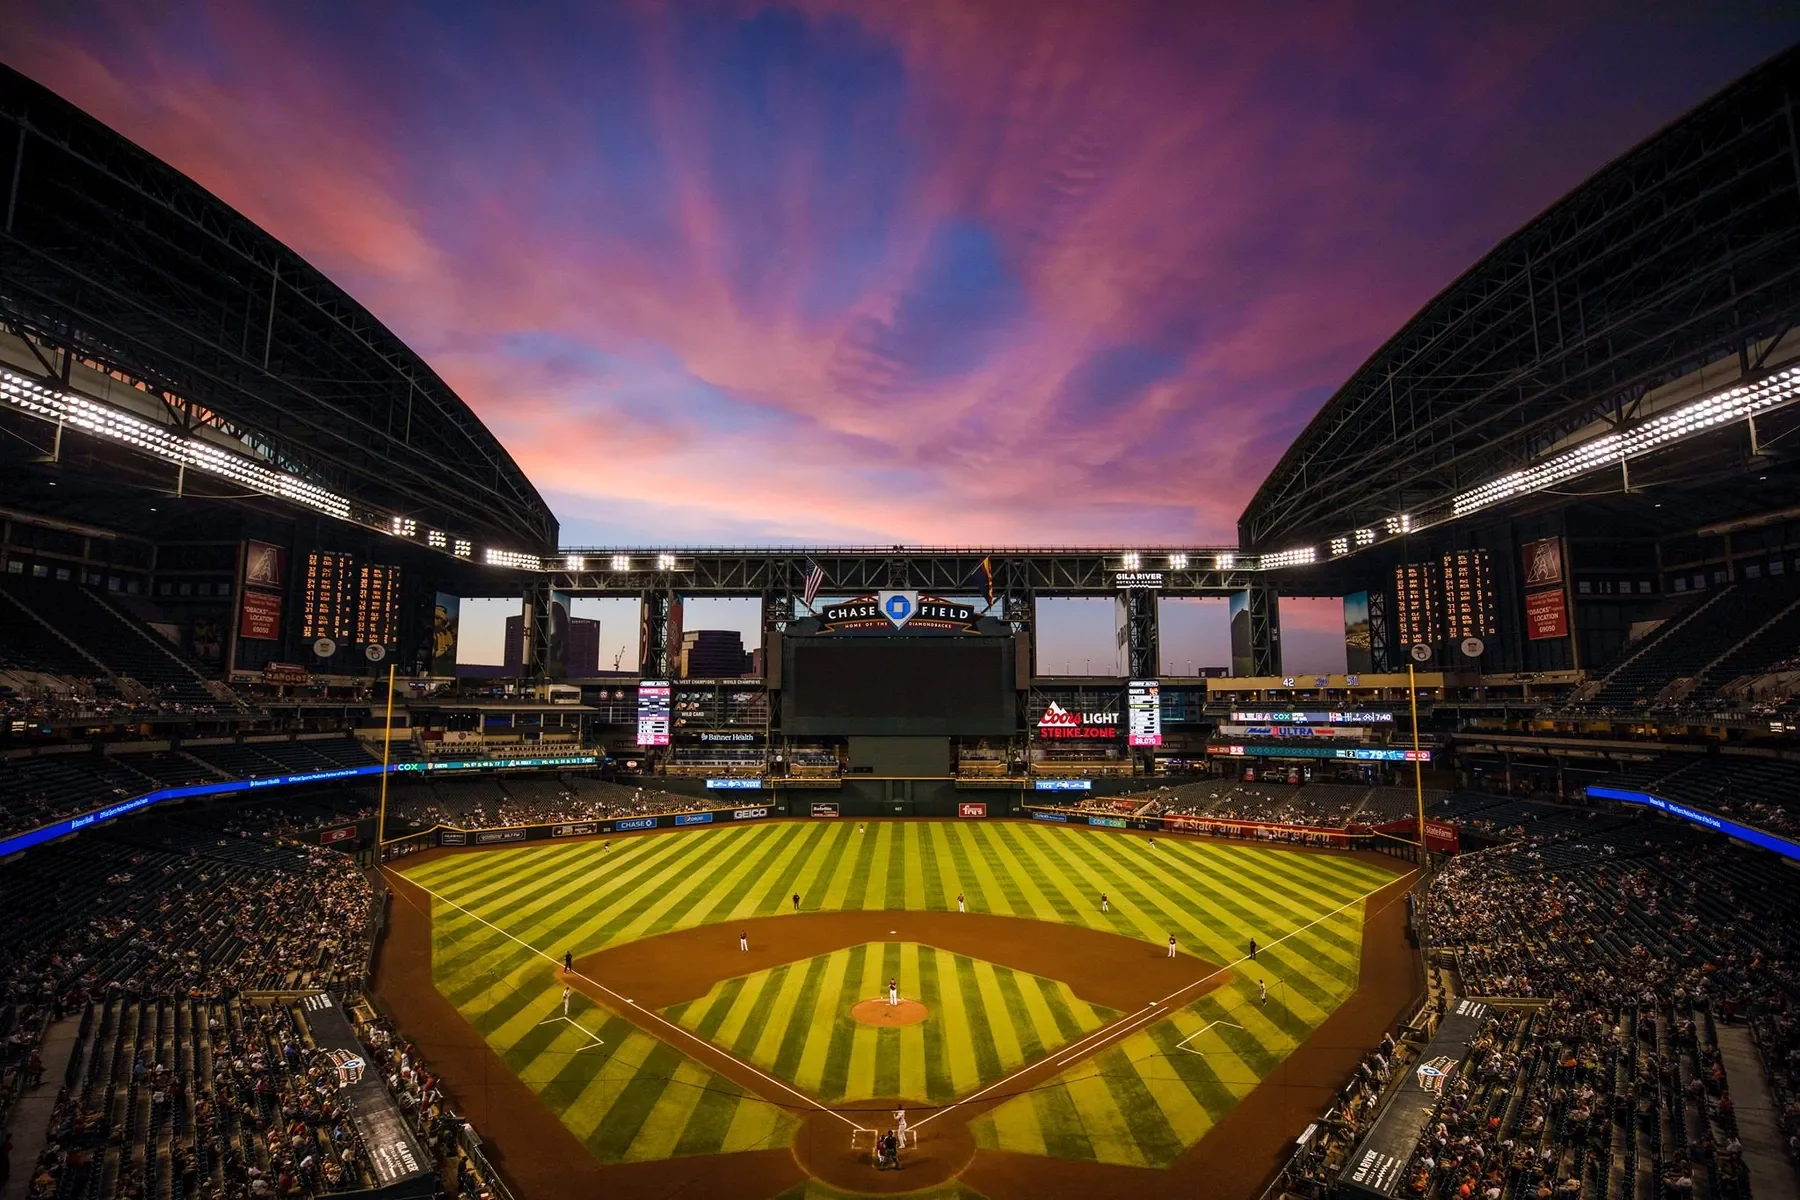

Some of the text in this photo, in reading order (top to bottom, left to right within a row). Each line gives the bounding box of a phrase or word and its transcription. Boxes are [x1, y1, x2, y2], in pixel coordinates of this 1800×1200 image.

[250, 614, 274, 622] LOCATION
[827, 606, 969, 620] CHASE FIELD
[1534, 612, 1559, 622] LOCATION
[1283, 678, 1294, 687] 42
[1040, 707, 1119, 724] Coors LIGHT
[1041, 728, 1116, 738] STRIKE ZONE
[1279, 728, 1314, 736] ULTRA
[734, 808, 767, 820] GEICO
[962, 805, 982, 815] fry's
[395, 1141, 419, 1172] GILA RIVER
[1352, 1148, 1378, 1182] GILA RIVER
